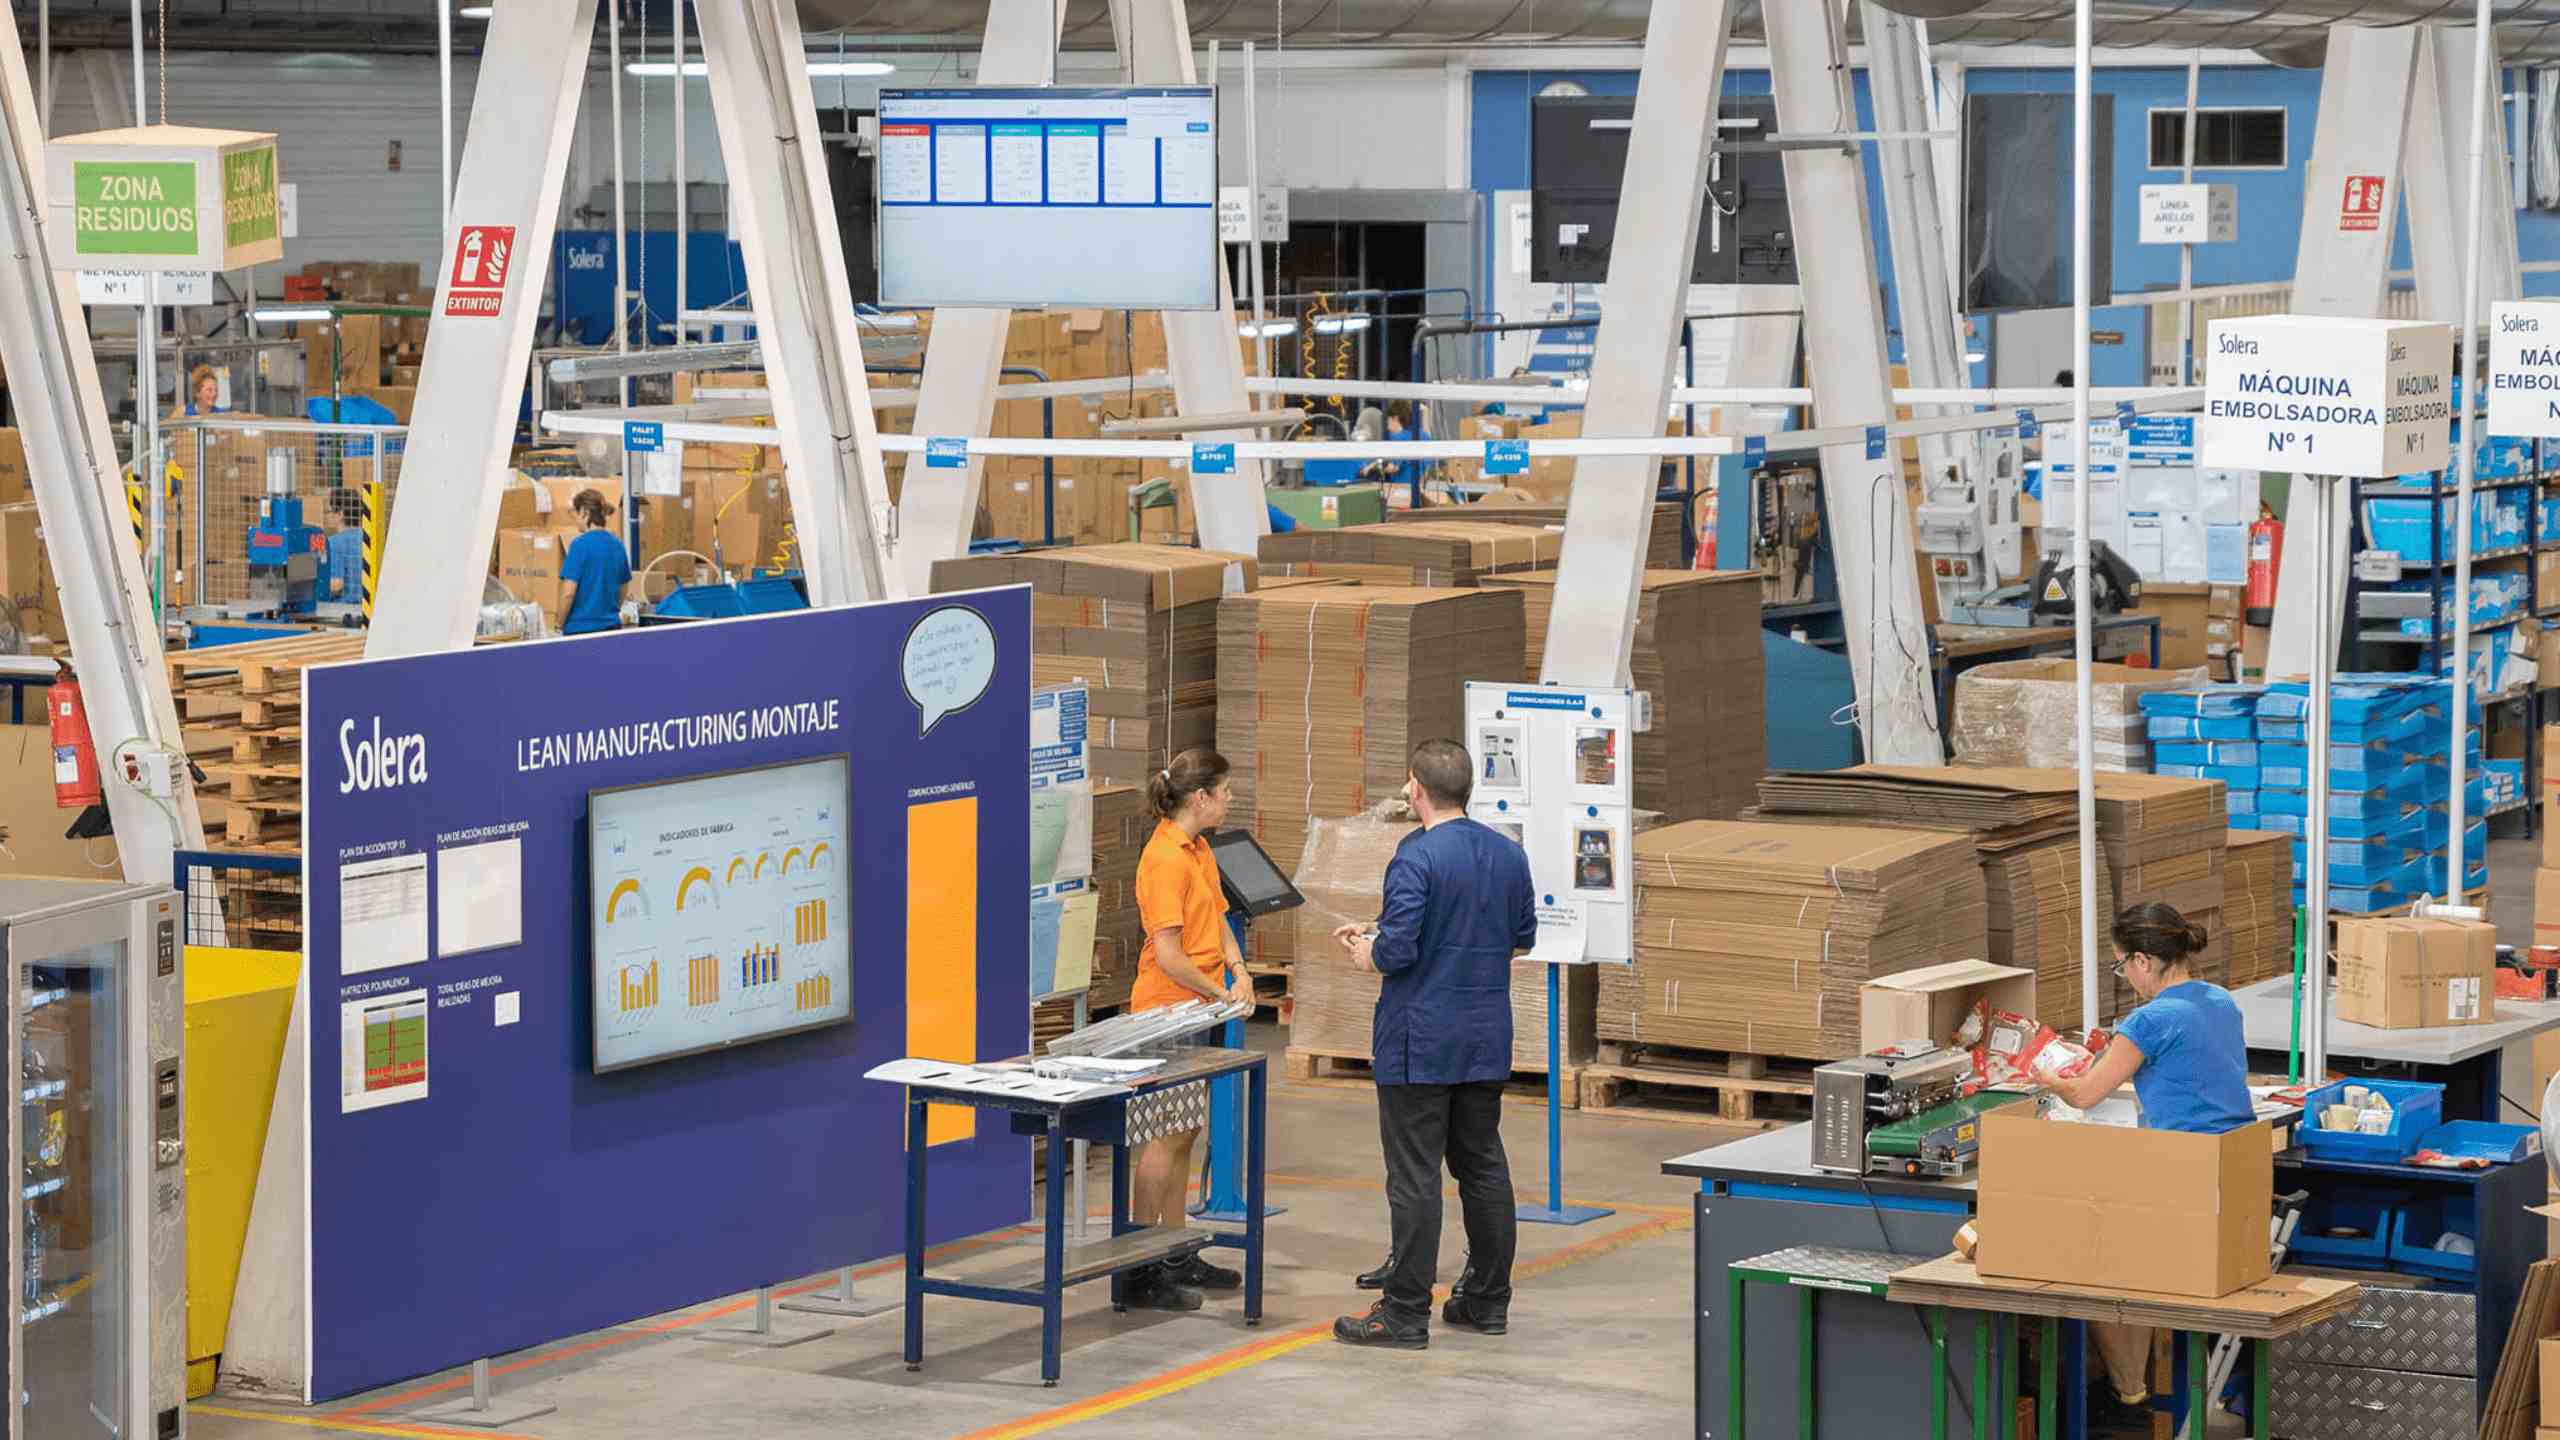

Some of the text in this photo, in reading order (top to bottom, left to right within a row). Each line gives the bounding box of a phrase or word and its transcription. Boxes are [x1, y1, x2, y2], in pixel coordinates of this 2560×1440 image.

[100, 176, 165, 201] ZONA
[233, 164, 262, 192] ZONA
[78, 206, 194, 232] RESIDUOS
[226, 191, 275, 225] RESIDUOS
[567, 247, 605, 269] Solera
[122, 283, 127, 293] 1
[447, 297, 500, 311] EXTINTOR
[2501, 313, 2539, 333] Solera
[2218, 333, 2260, 355] Solera
[2520, 344, 2560, 367] MÁ
[2238, 369, 2352, 398] MÁQUINA
[2396, 372, 2440, 397] MÁQUINA
[2210, 400, 2378, 426] EMBOLSADORA
[2386, 402, 2449, 426] EMBOLSADORA
[2268, 432, 2315, 454] Nº 1
[516, 699, 840, 772] LEAN MANUFACTURING MONTAJE
[339, 715, 429, 796] Solera
[436, 833, 451, 844] PLAN
[452, 831, 460, 840] DE
[482, 825, 498, 836] IDEAS
[499, 823, 507, 834] DE
[508, 821, 529, 833] MEJORA
[659, 827, 699, 843] INDICADORES
[340, 848, 355, 858] PLAN
[355, 846, 364, 856] DE
[386, 840, 398, 851] TOP
[399, 839, 407, 850] 15
[340, 976, 410, 996] MATRIZ DE POLIVALENCIA
[437, 975, 503, 995] TOTAL IDEAS DE MEJORA
[437, 992, 472, 1008] REALIZADAS
